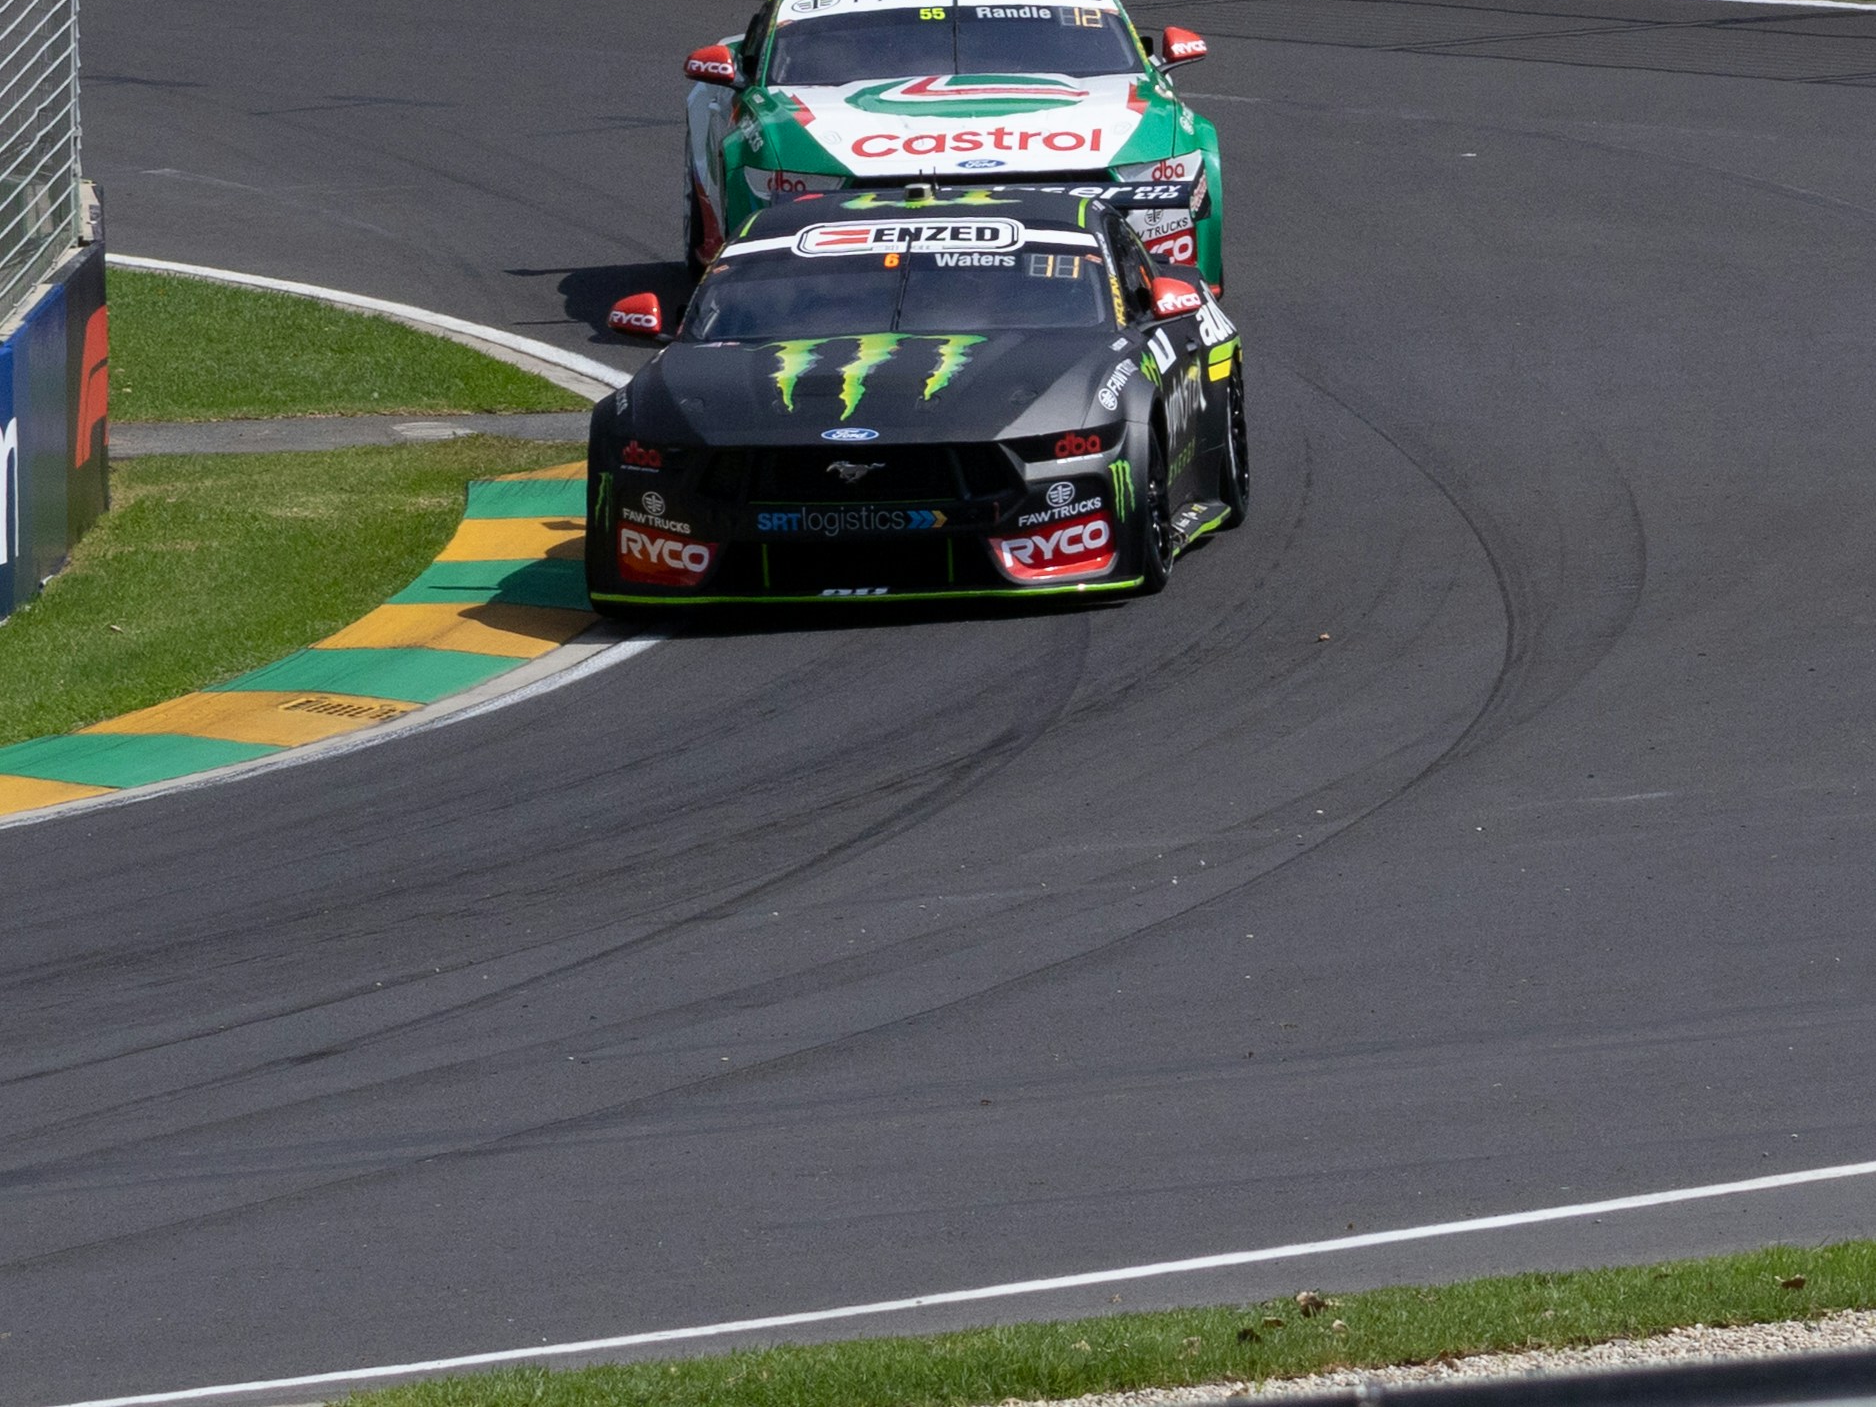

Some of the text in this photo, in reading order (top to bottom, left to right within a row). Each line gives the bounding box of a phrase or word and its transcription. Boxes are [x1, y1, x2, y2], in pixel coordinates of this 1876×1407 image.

[919, 7, 946, 20] 55
[976, 6, 1052, 19] Randle
[687, 59, 733, 75] RYCO
[1152, 161, 1185, 181] dba
[1135, 185, 1181, 193] PTY
[873, 226, 1000, 243] ENZED
[1147, 217, 1188, 238] TRUCKS
[884, 253, 899, 268] 6
[935, 253, 1016, 267] Waters
[609, 311, 658, 327] RYCO
[1055, 431, 1101, 458] dba
[1019, 497, 1102, 527] FAW TRUCKS
[623, 508, 691, 534] FAW TRUCKS
[621, 528, 710, 572] RYCO
[1001, 520, 1110, 568] RYCO
